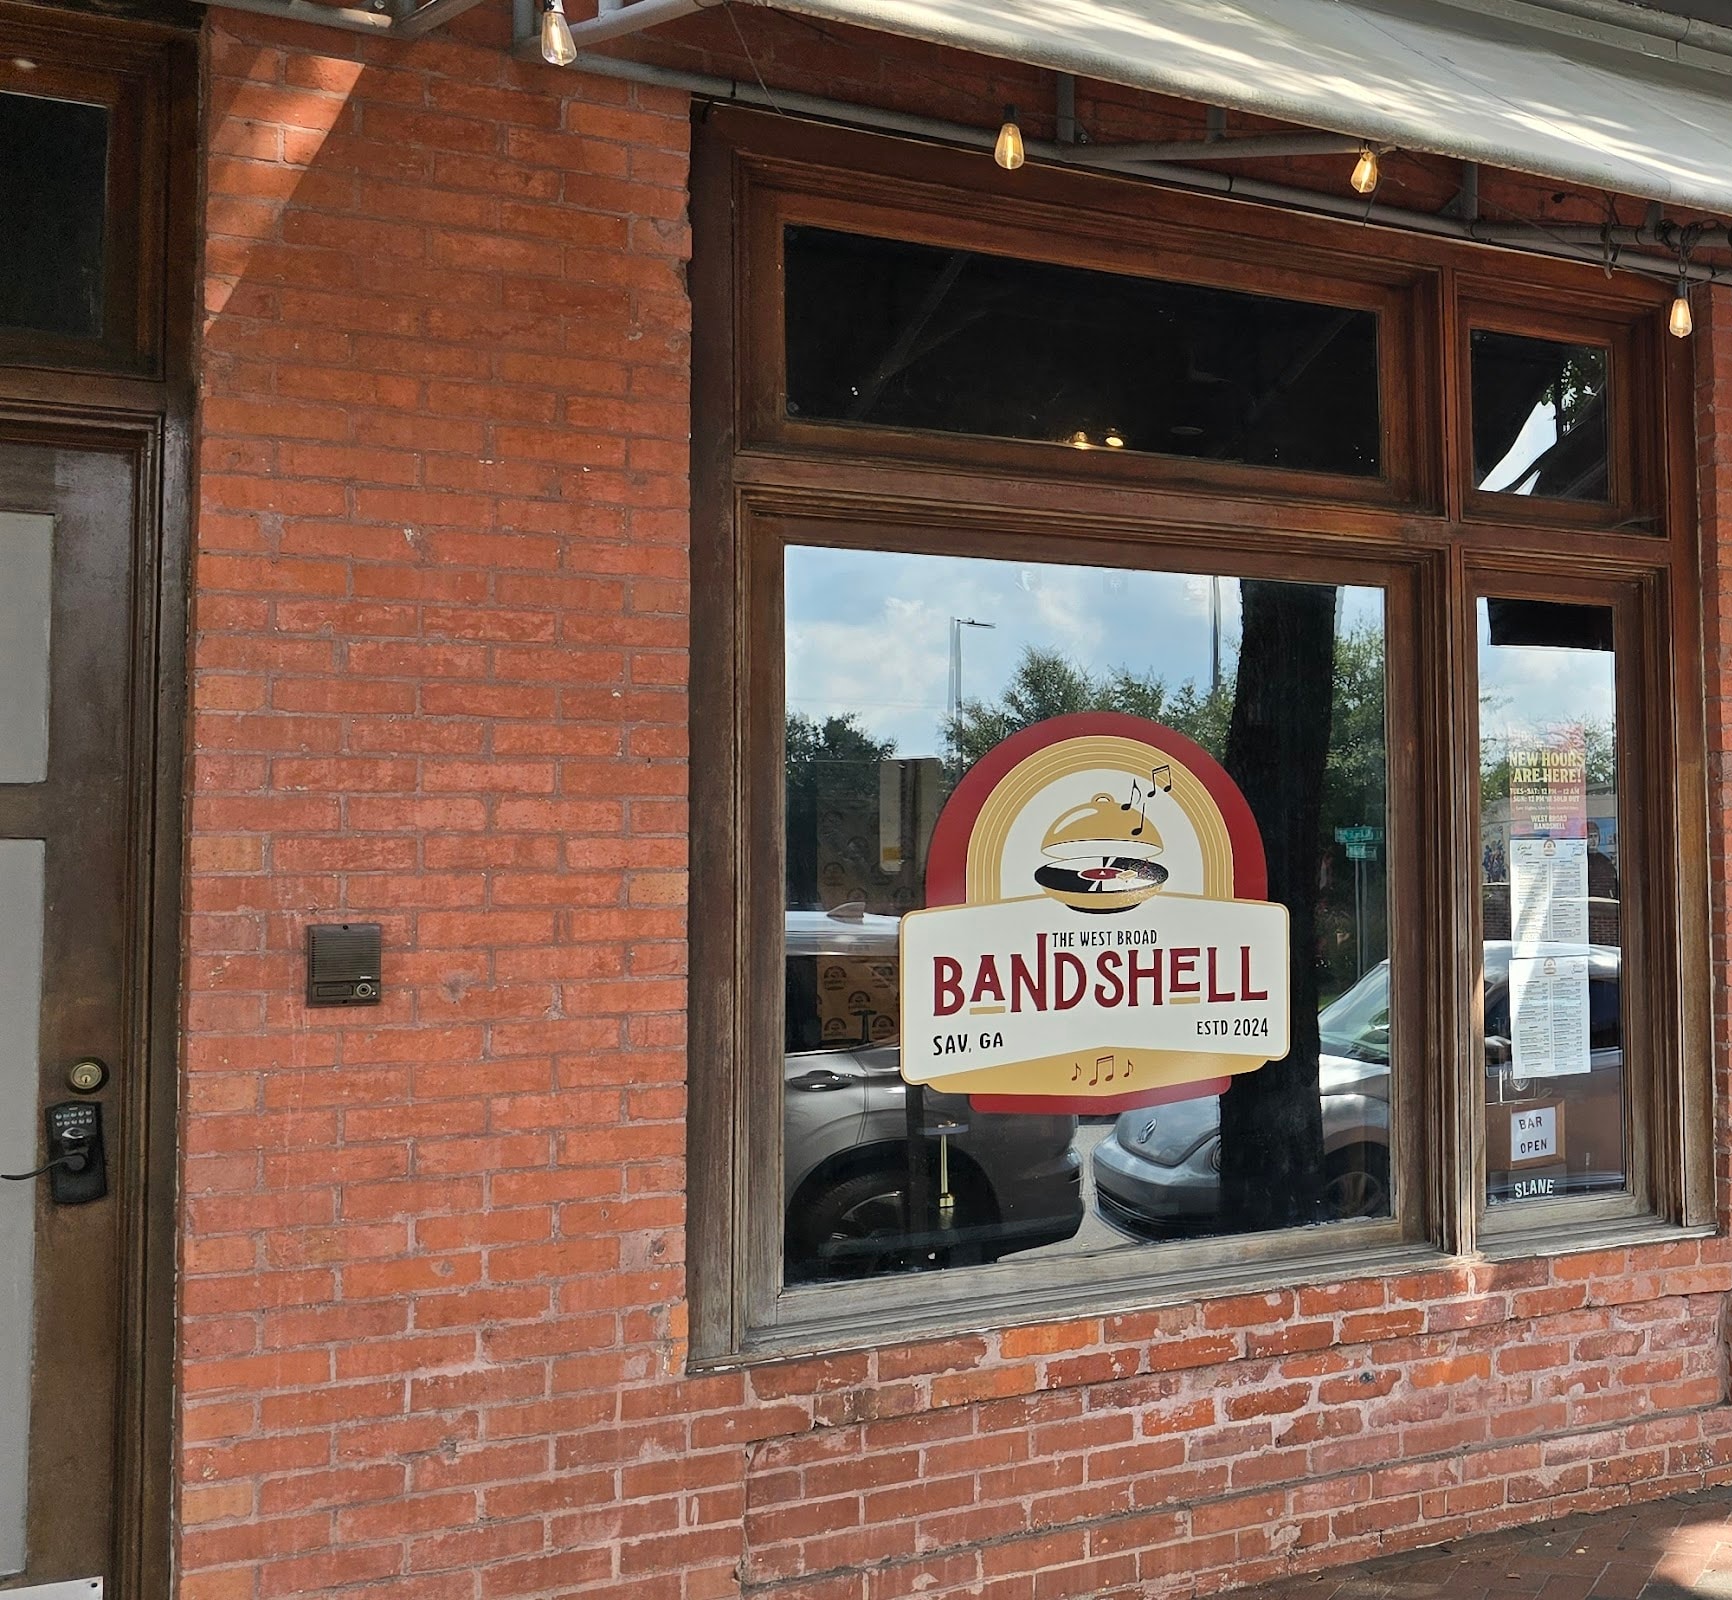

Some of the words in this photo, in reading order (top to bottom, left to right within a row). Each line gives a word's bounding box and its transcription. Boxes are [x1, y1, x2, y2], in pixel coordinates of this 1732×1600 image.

[1509, 750, 1538, 766] NEW
[1542, 750, 1585, 767] HOURS
[1513, 768, 1539, 783] ARE
[1543, 768, 1581, 783] HERE!
[1530, 814, 1548, 822] WEST
[1052, 932, 1075, 948] THE
[1079, 931, 1113, 947] WEST
[1116, 929, 1158, 945] BROAD
[932, 933, 1268, 1017] BANDSHELL
[1196, 1019, 1229, 1036] ESTD
[1233, 1017, 1269, 1038] 2024
[979, 1031, 1004, 1050] GA
[1518, 1116, 1543, 1130] BAR
[1520, 1138, 1547, 1154] OPEN
[1514, 1179, 1555, 1198] SLANE
